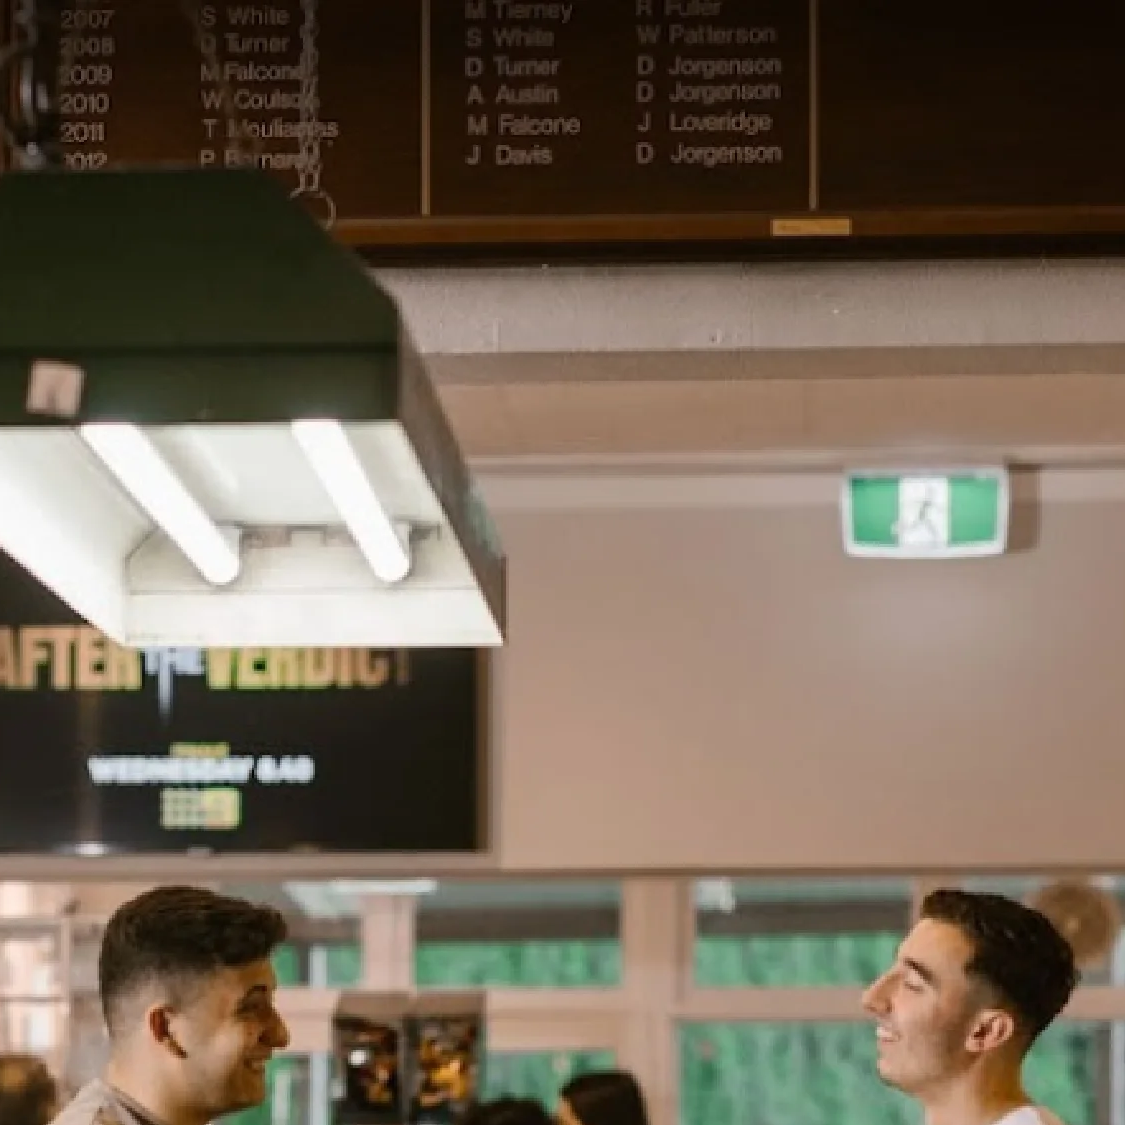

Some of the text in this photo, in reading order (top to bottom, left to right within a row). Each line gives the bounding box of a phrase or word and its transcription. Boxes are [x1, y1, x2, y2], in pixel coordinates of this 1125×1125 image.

[60, 10, 116, 28] 2007
[201, 5, 290, 25] S White
[224, 32, 290, 53] Turner
[467, 26, 555, 47] S White
[635, 24, 779, 46] W Patterson
[201, 62, 220, 81] M
[465, 55, 562, 77] D Turner
[637, 55, 782, 79] D Jorgenson
[59, 93, 110, 114] 2010
[201, 88, 222, 110] W
[466, 83, 560, 104] A Austin
[636, 81, 782, 105] D Jorgenson
[59, 120, 106, 142] 2011
[202, 118, 217, 139] T
[467, 114, 581, 136] M Falcone
[636, 109, 774, 136] J Loveridge
[465, 144, 553, 166] J Davis
[636, 142, 783, 168] D Jorgenson
